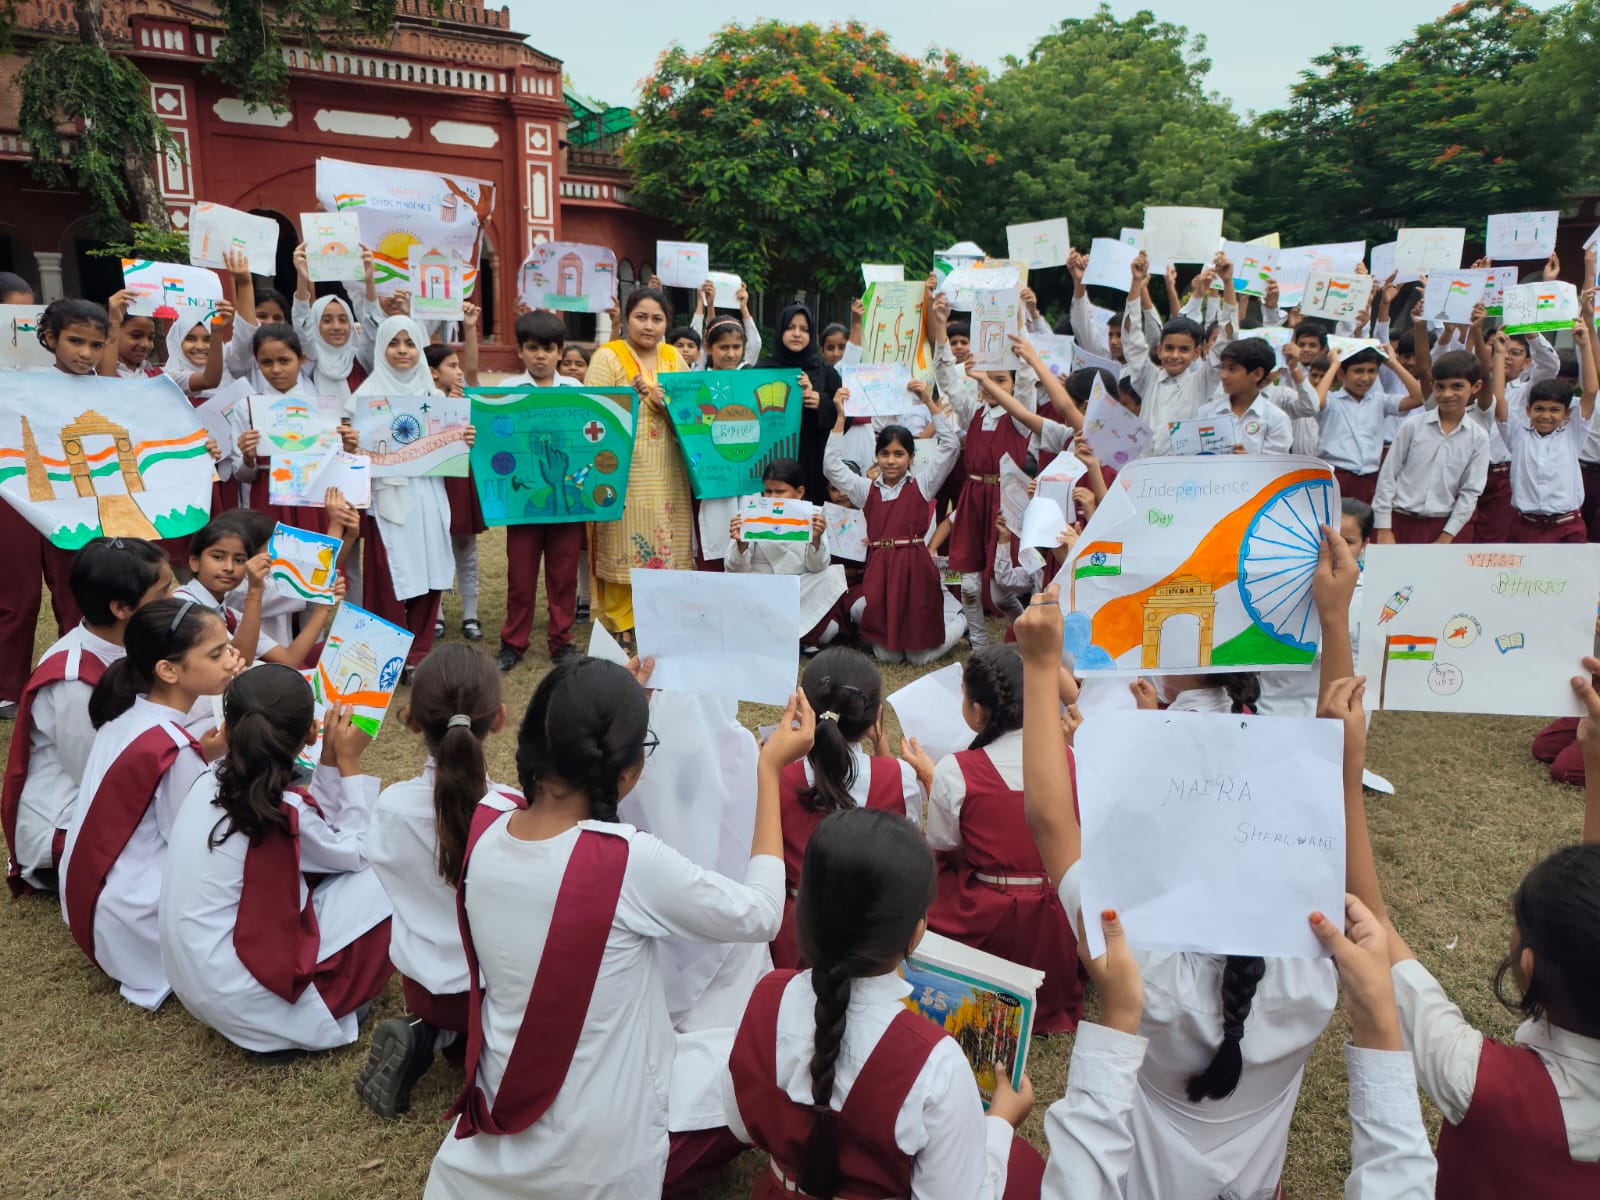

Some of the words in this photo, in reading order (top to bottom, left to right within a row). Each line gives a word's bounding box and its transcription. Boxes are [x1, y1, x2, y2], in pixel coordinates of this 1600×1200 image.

[175, 295, 216, 310] INDI
[1135, 478, 1250, 503] Independence
[1148, 508, 1174, 529] Day
[1168, 587, 1195, 596] INDIA
[1490, 572, 1569, 598] BHARAT
